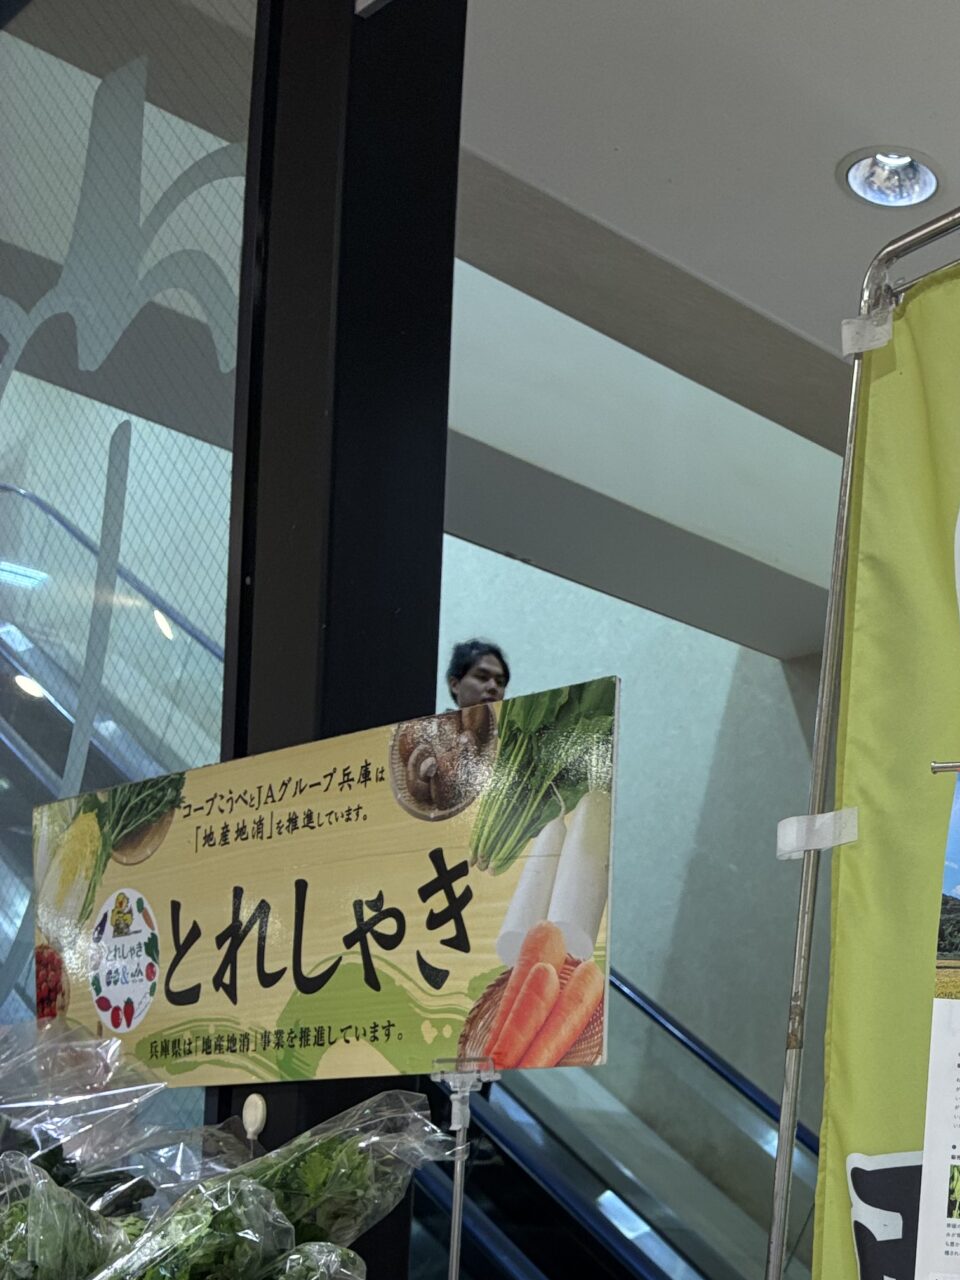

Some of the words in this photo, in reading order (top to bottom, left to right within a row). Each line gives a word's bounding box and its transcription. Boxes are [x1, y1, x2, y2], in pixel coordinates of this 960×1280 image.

[182, 764, 387, 821] コープこうべとJAグループ兵庫は
[194, 806, 369, 853] 「地産地消」を推進しています。
[148, 1019, 405, 1061] 兵庫県は「地産地消」事業を推進しています。
